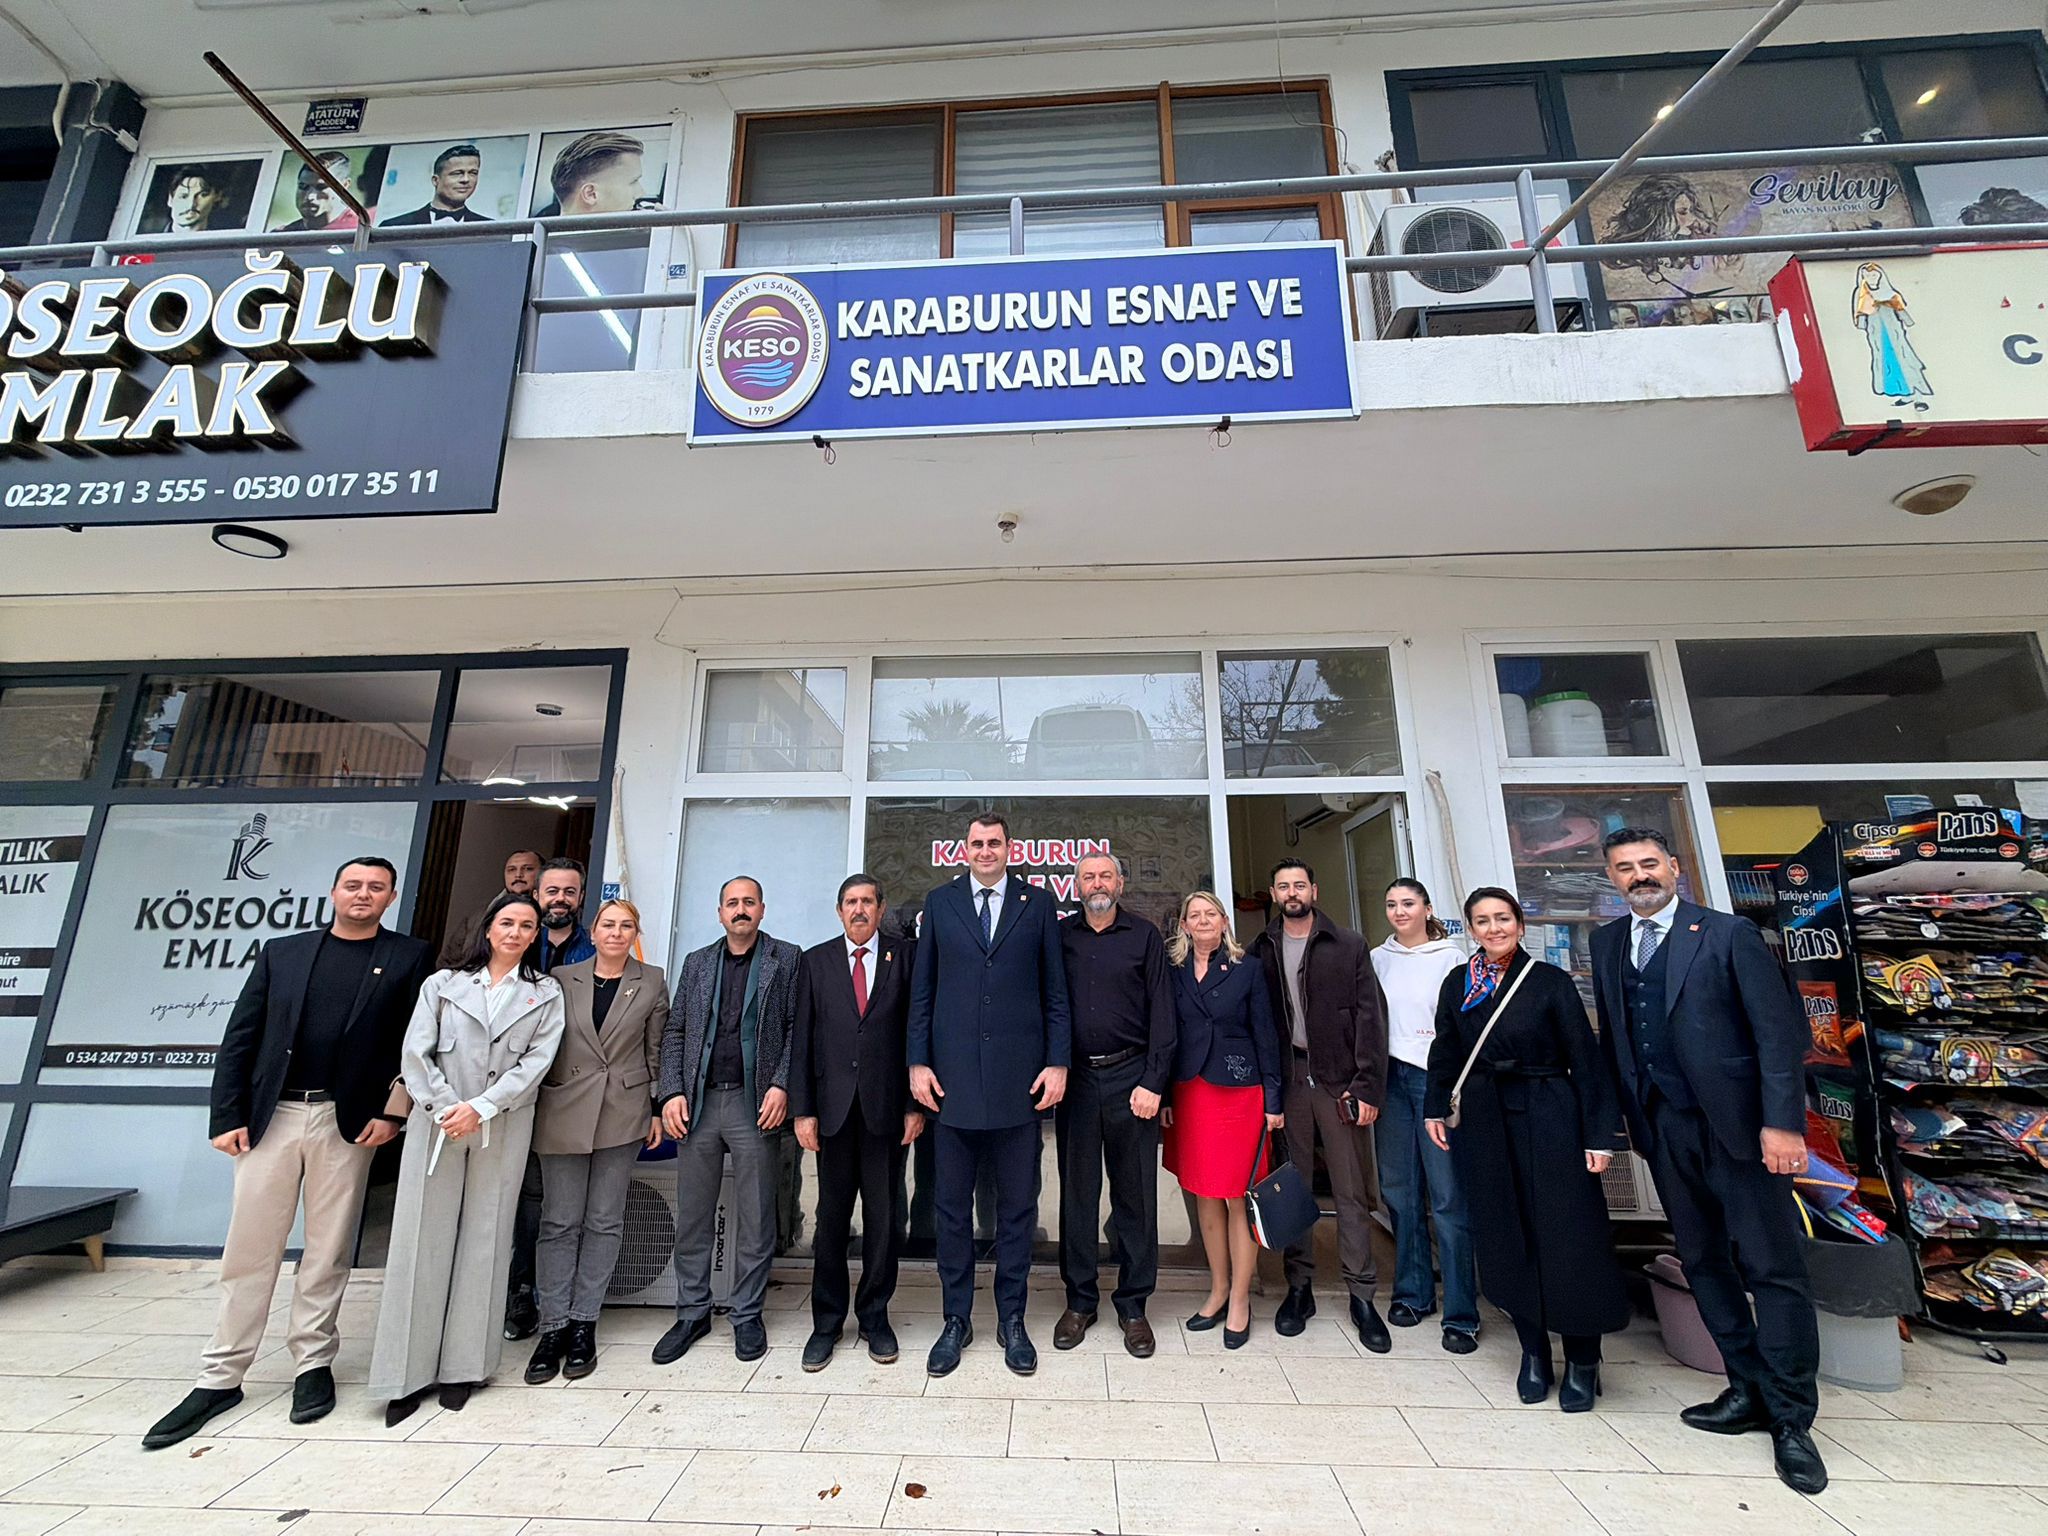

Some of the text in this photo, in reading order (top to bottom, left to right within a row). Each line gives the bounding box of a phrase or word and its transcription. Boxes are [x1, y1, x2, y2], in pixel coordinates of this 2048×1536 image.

[1748, 170, 1898, 210] Sevilay
[0, 248, 430, 358] SEOĞLU
[837, 277, 1304, 340] KARABURUN ESNAF VE
[705, 281, 822, 368] KARABURUN ESNAF VE SANATKARLAR ODASI
[723, 336, 801, 359] KESO
[848, 339, 1294, 398] SANATKARLAR ODASI
[748, 406, 774, 416] 1979
[6, 483, 68, 507] 0232
[79, 481, 126, 505] 731
[131, 481, 151, 503] 3
[156, 478, 208, 502] 555
[233, 475, 300, 500] 0530
[306, 472, 359, 497] 017
[364, 471, 399, 496] 35
[409, 469, 440, 493] 11
[1854, 823, 1900, 841] Cipso
[932, 839, 1110, 866] KABURUN
[1778, 890, 1828, 903] Türkiye'nin
[1792, 905, 1816, 917] Cipsi
[163, 938, 264, 969] EMLA
[66, 1052, 74, 1063] 0
[76, 1052, 97, 1063] 534
[99, 1052, 120, 1063] 247
[123, 1052, 139, 1063] 29
[140, 1052, 154, 1063] 51
[165, 1052, 192, 1064] 0232
[196, 1052, 216, 1063] 731
